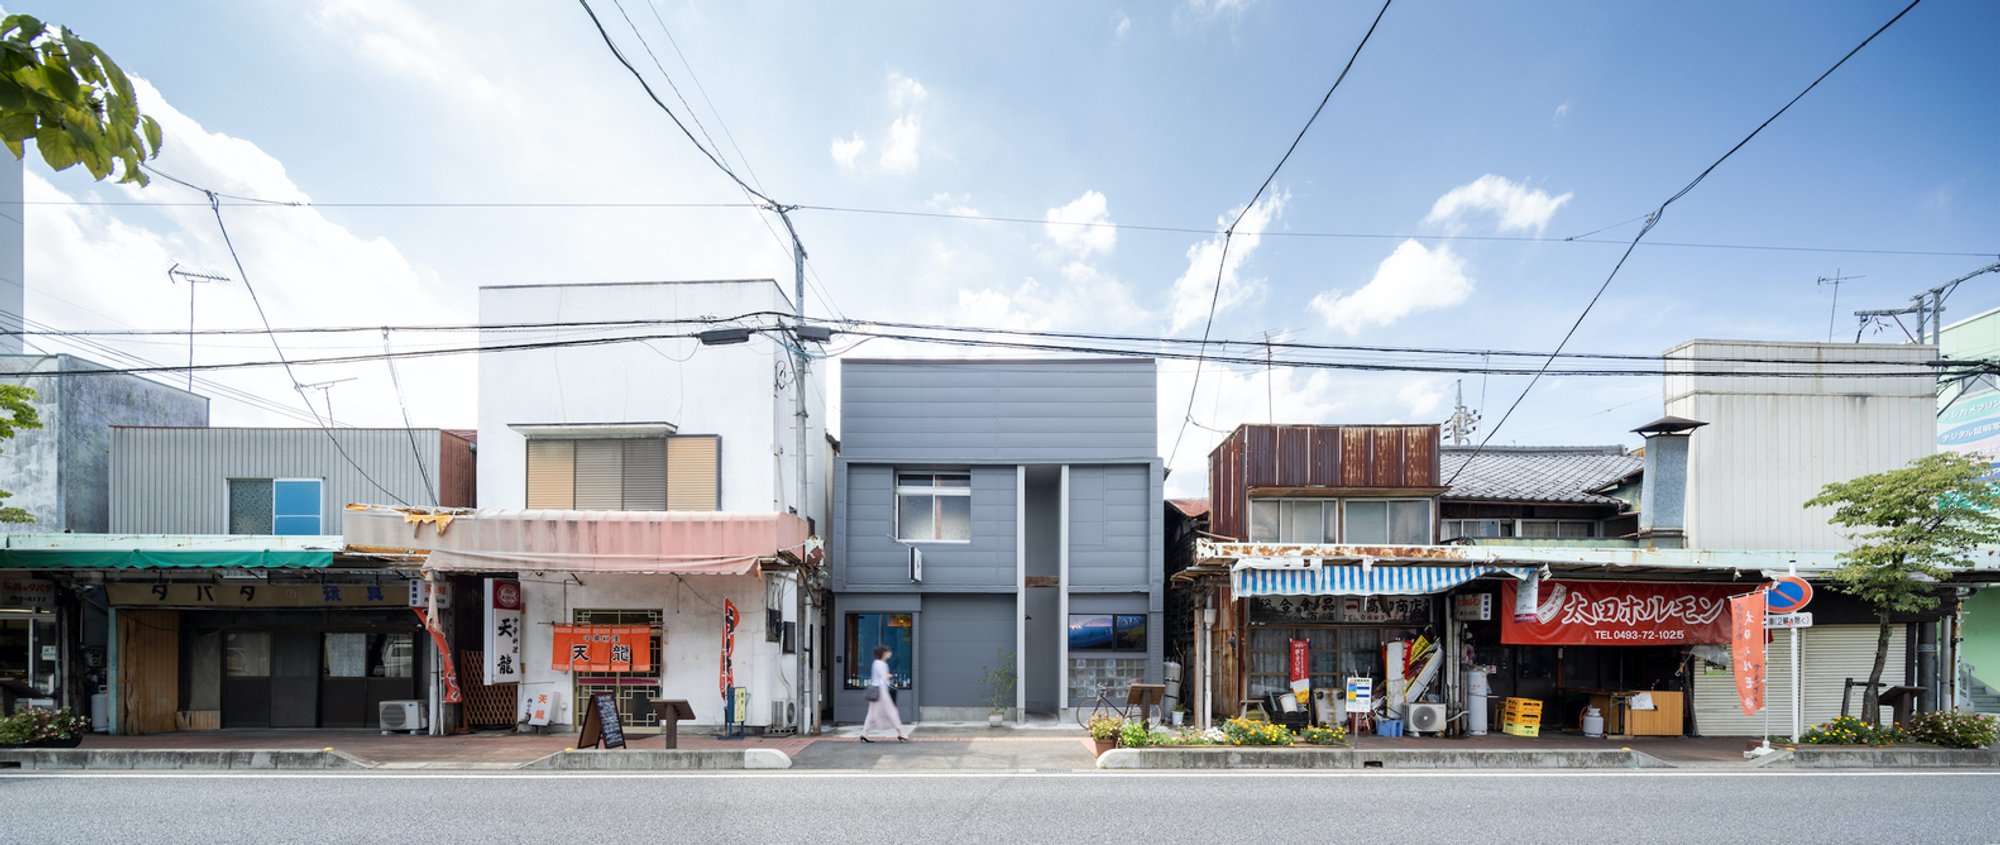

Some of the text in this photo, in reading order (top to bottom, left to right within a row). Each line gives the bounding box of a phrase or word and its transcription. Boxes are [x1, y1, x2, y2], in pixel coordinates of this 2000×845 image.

[1561, 591, 1725, 626] 太田ホルモン
[498, 618, 514, 675] 天龍
[1594, 630, 1685, 640] TEL 0493-72-1025
[572, 644, 629, 662] 天龍
